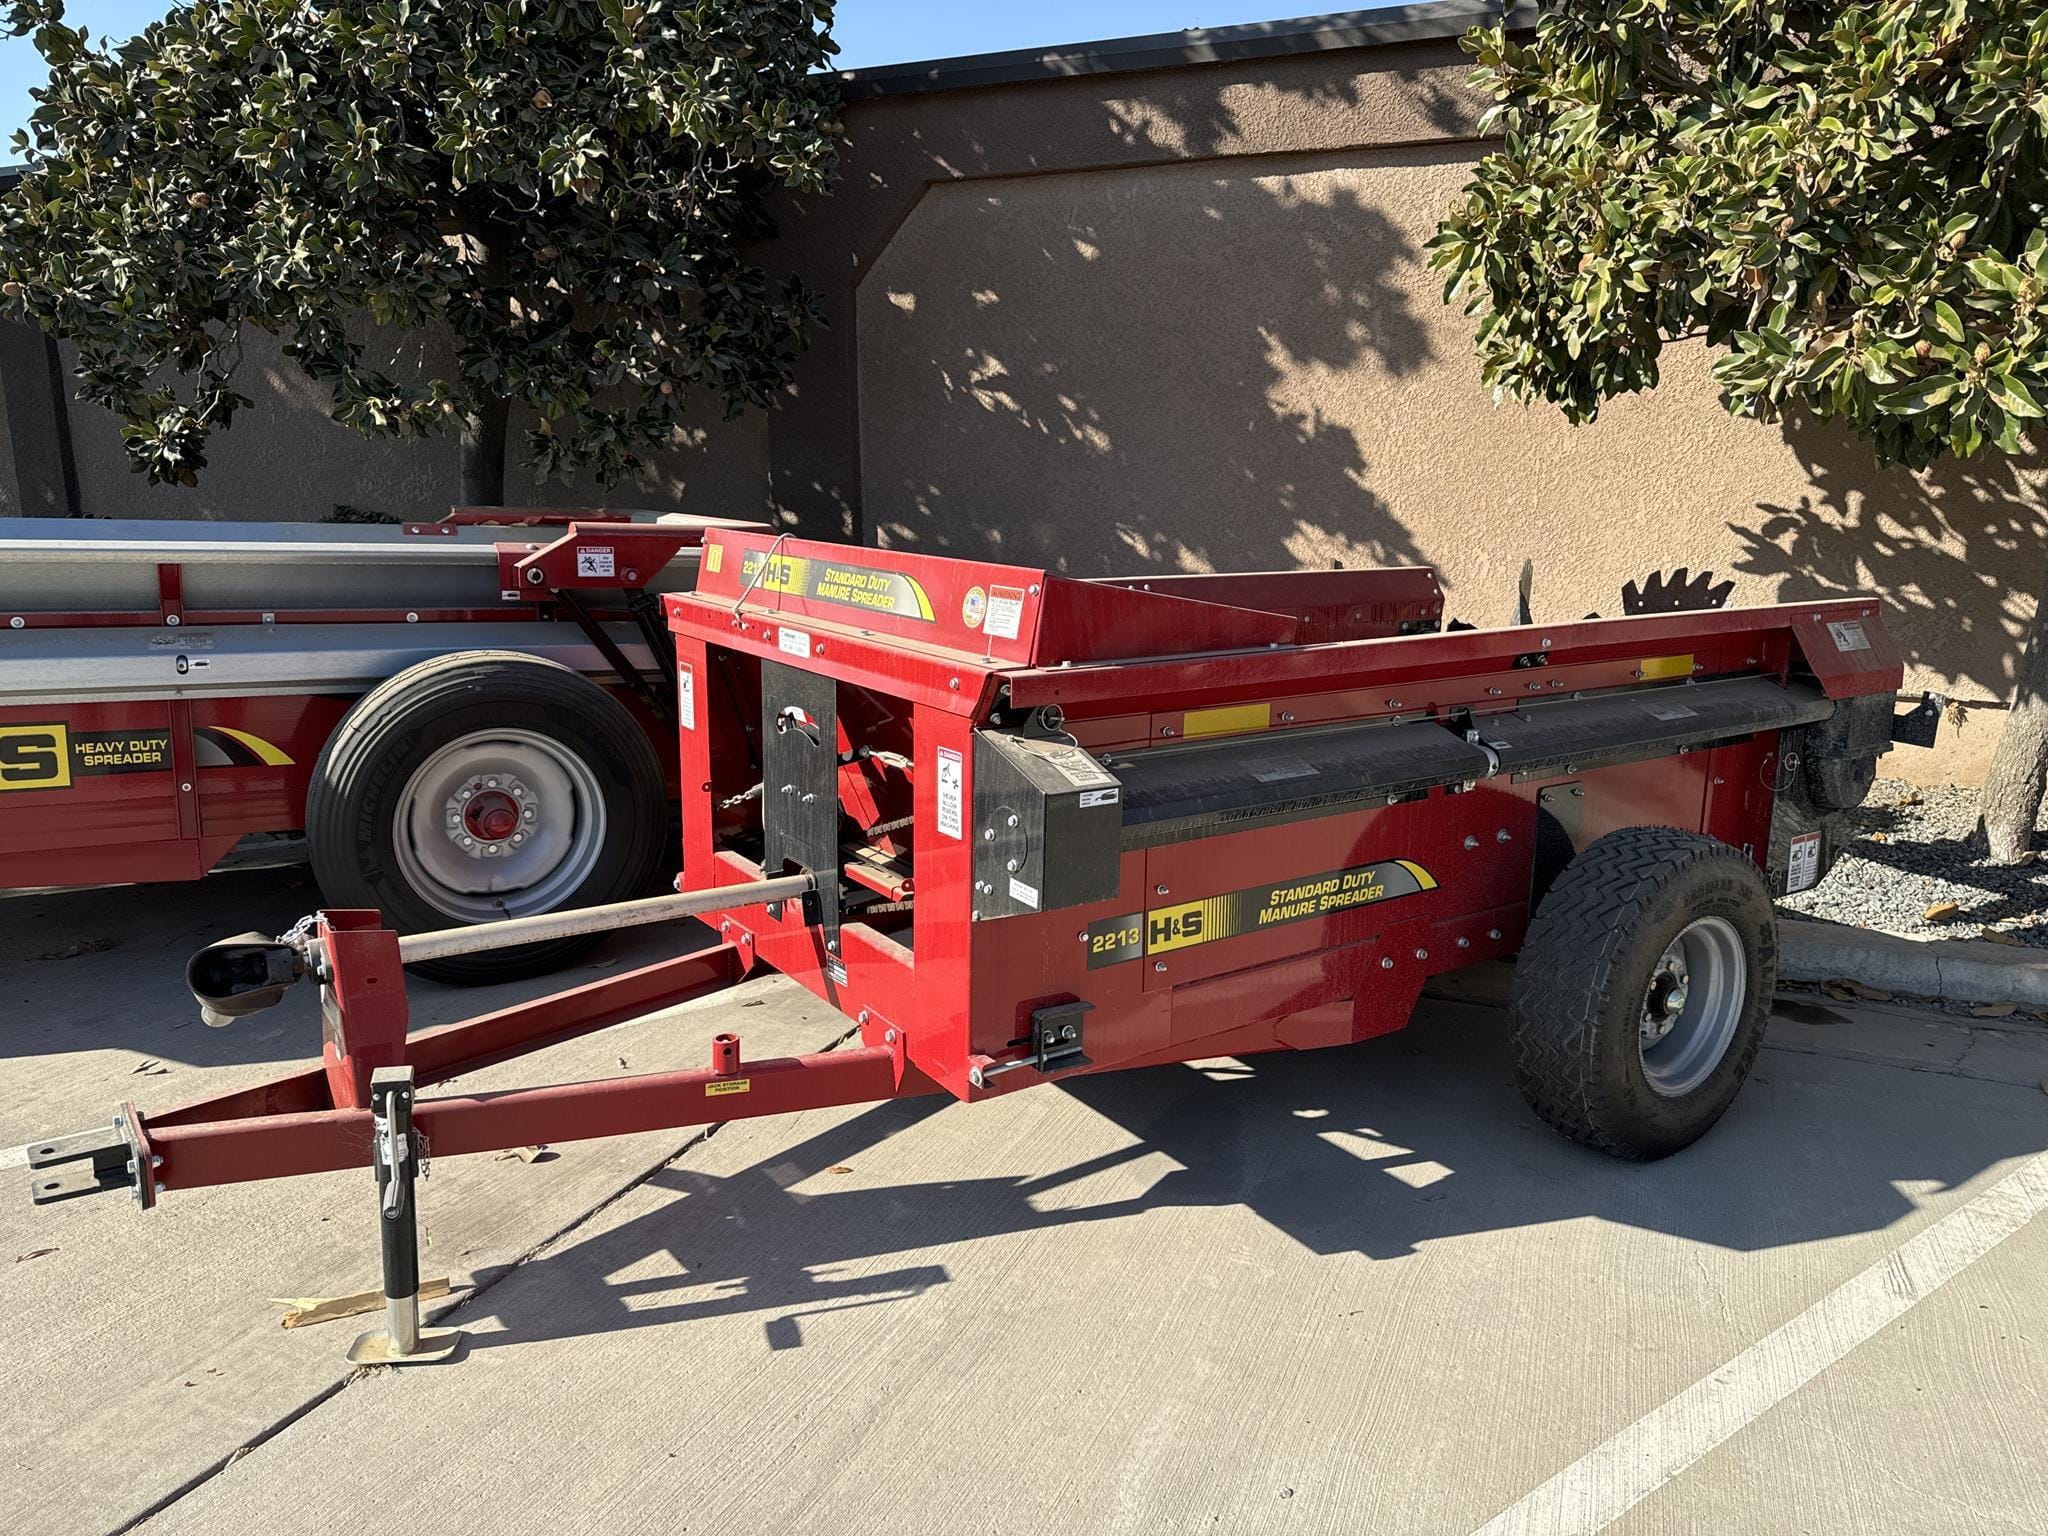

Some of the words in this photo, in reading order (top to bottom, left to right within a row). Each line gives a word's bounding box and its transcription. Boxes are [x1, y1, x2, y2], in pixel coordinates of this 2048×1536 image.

[765, 561, 791, 586] H&S
[825, 568, 867, 588] STANDARD
[868, 575, 892, 593] DUTY
[816, 583, 850, 601] MANURE
[850, 588, 896, 609] SPREADER
[75, 741, 124, 754] HEAVY
[130, 739, 168, 752] DUTY
[84, 751, 162, 767] SPREADER
[358, 735, 412, 844] MICHELIN
[1270, 879, 1340, 906] STANDARD
[1342, 871, 1376, 891] DUTY
[1258, 901, 1317, 925] MANURE
[1319, 885, 1385, 911] SPREADER
[1092, 927, 1140, 953] 2213
[1150, 910, 1203, 947] H&S
